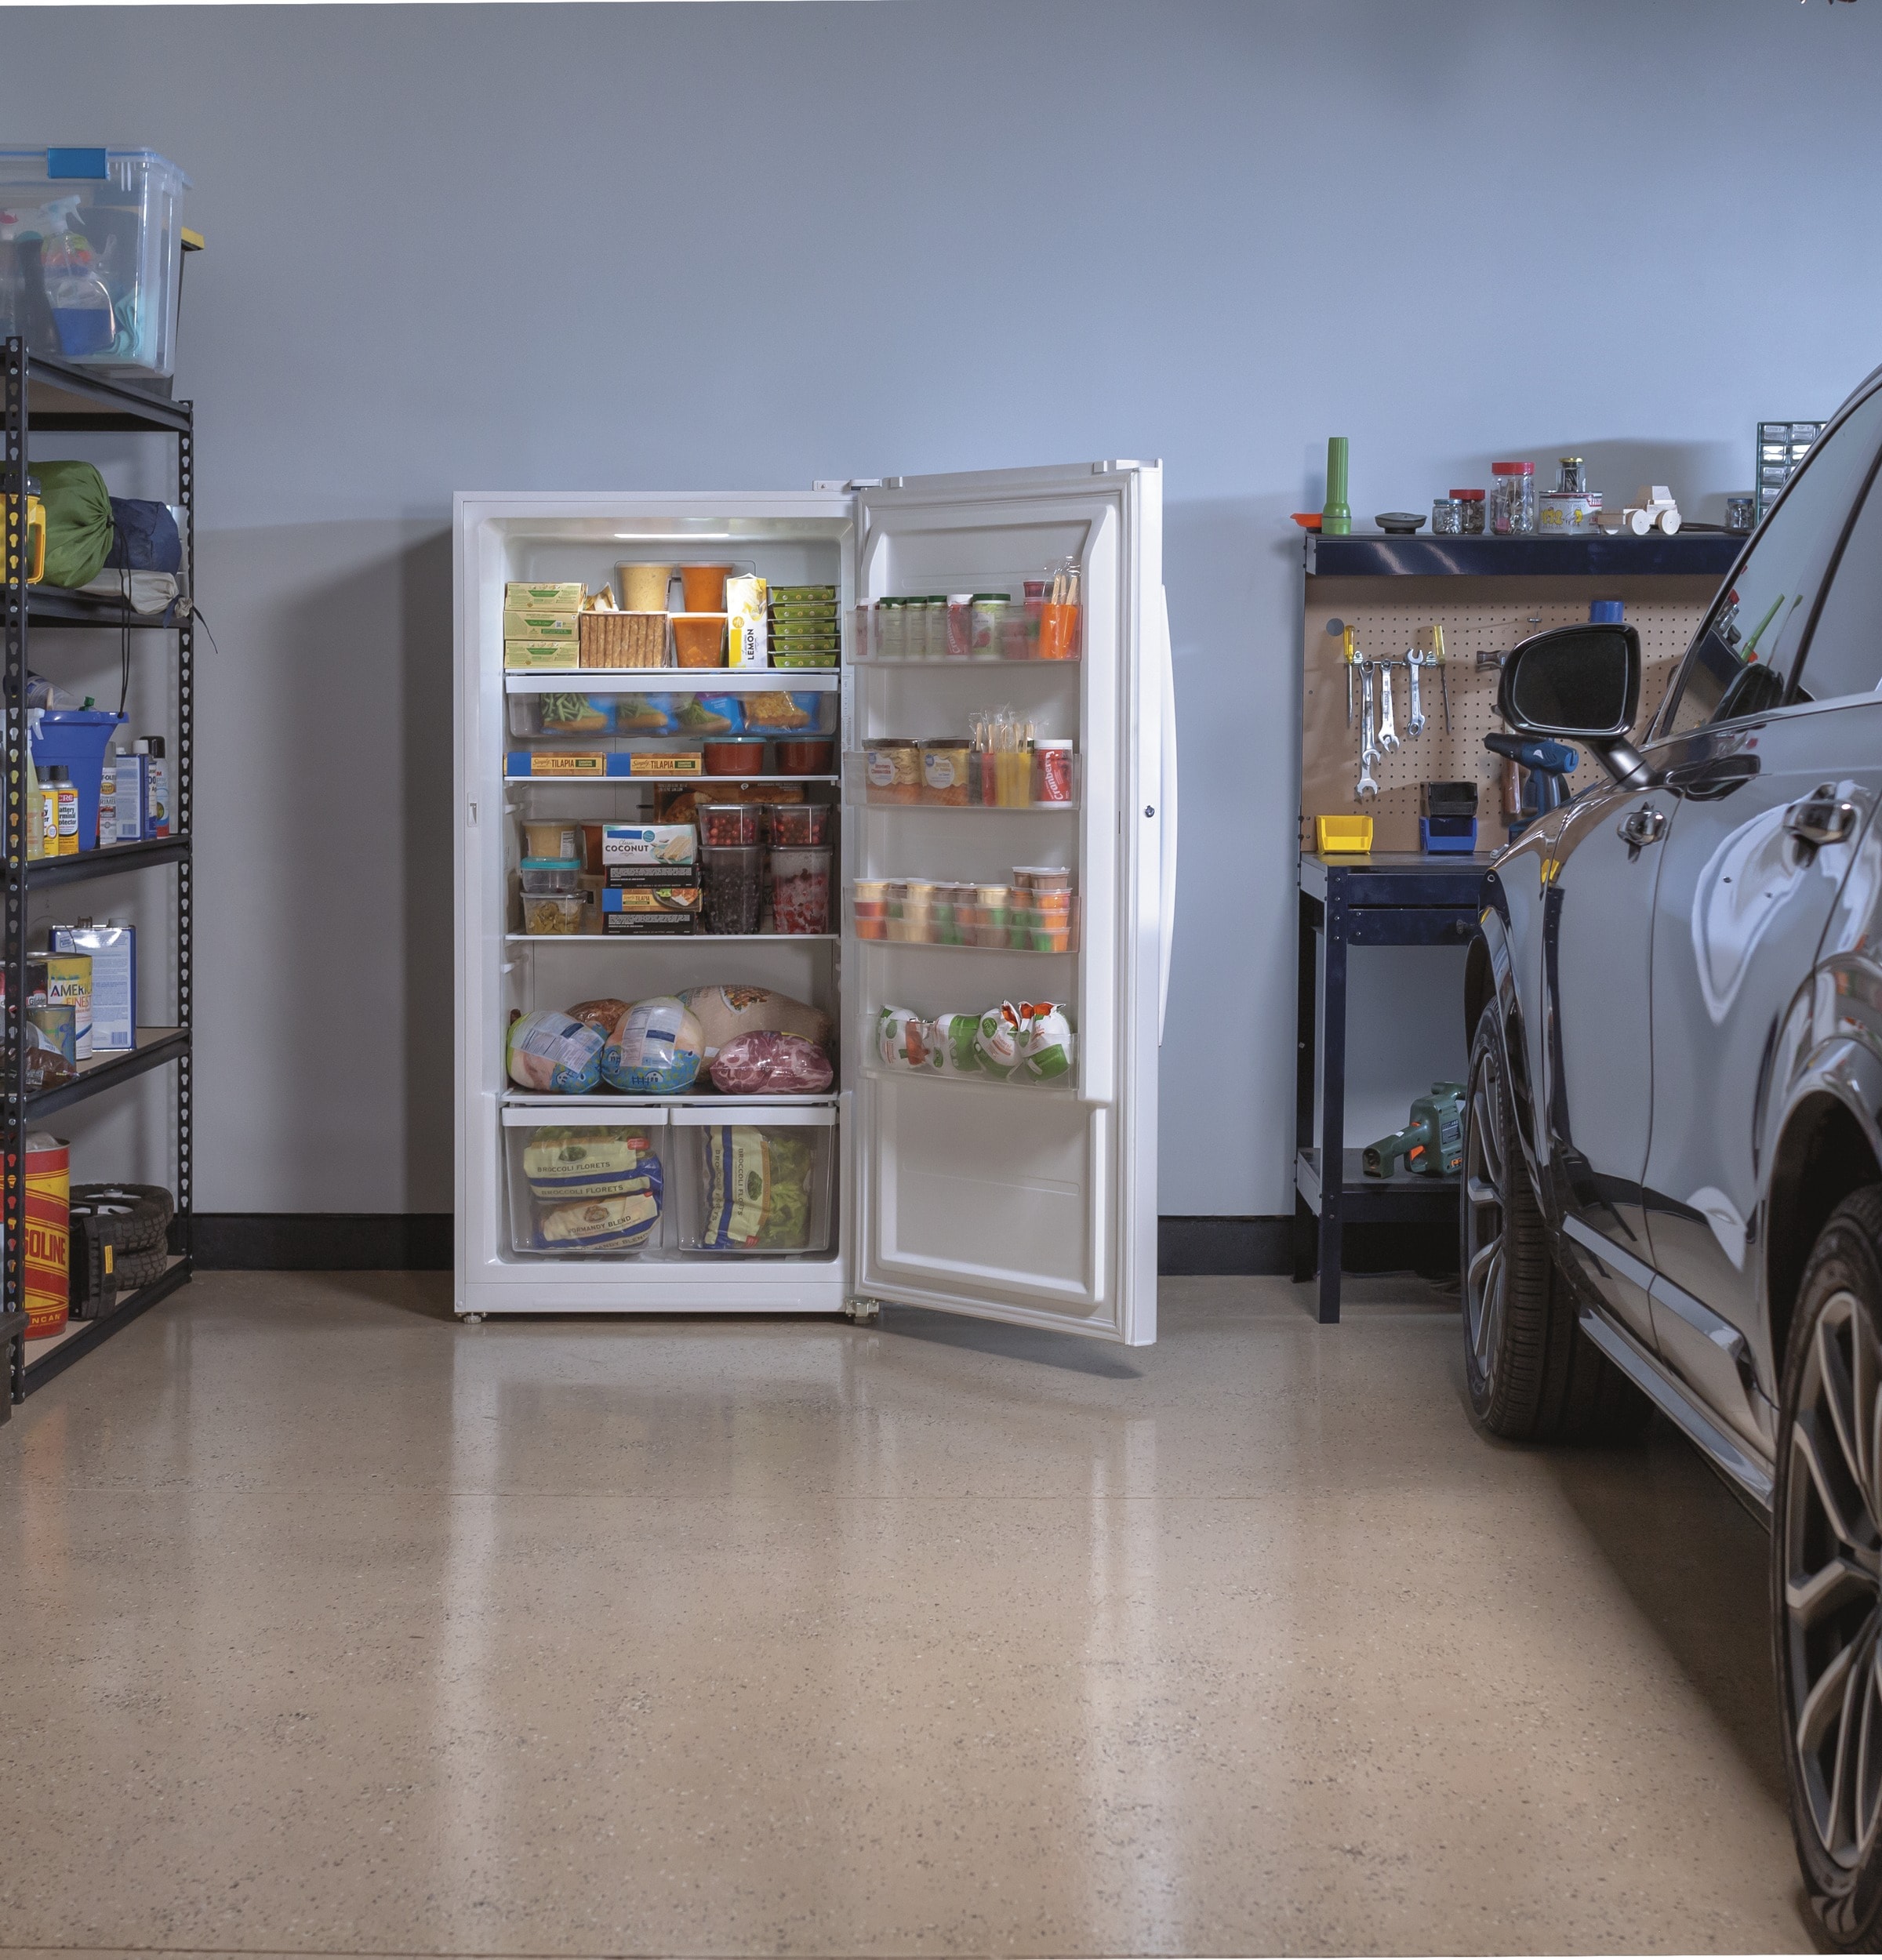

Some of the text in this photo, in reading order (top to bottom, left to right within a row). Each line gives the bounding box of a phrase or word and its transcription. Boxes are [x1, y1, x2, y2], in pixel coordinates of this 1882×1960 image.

[551, 759, 575, 768] TILAPIA
[650, 760, 674, 769] TILAPIA
[1045, 750, 1063, 800] Cranberry
[58, 793, 74, 801] CRC
[59, 806, 75, 815] attery
[576, 1161, 611, 1171] FLORETS
[585, 1185, 624, 1194] FLORETS
[608, 1215, 631, 1228] BLEND
[31, 1312, 61, 1324] NCAN
